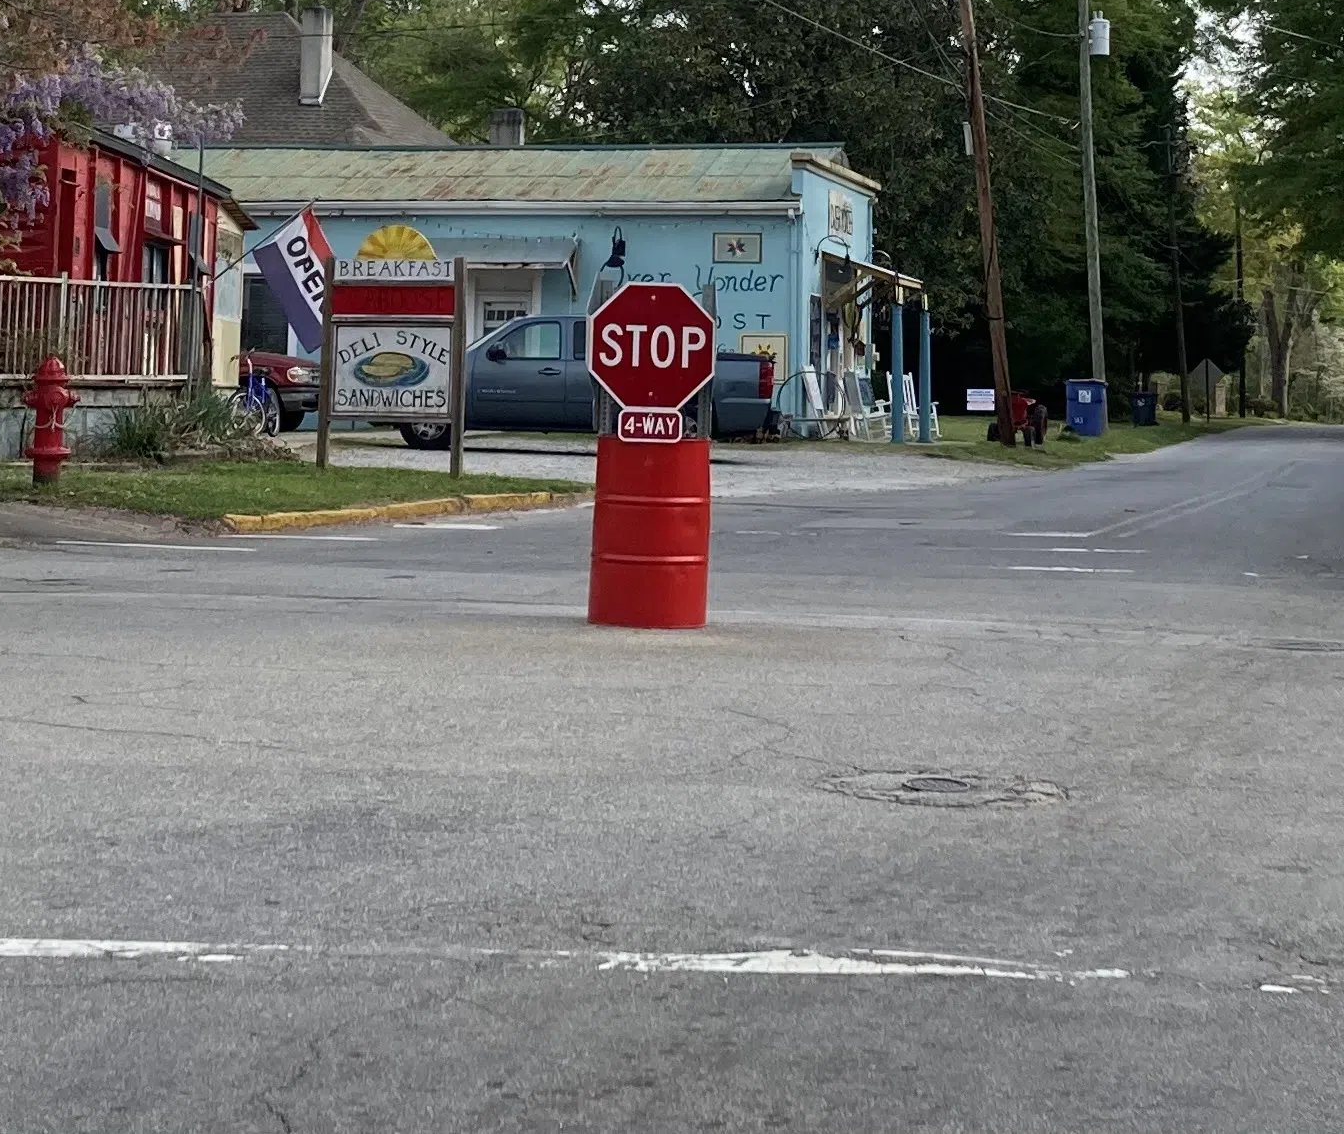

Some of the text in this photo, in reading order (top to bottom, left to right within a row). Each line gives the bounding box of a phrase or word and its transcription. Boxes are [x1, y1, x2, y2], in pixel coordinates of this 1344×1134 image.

[338, 260, 453, 278] BREAKFAST
[338, 330, 449, 365] DELI STYLE
[598, 323, 707, 369] STOP
[336, 388, 446, 409] SANDWICHES
[624, 416, 677, 435] 4-WAY
